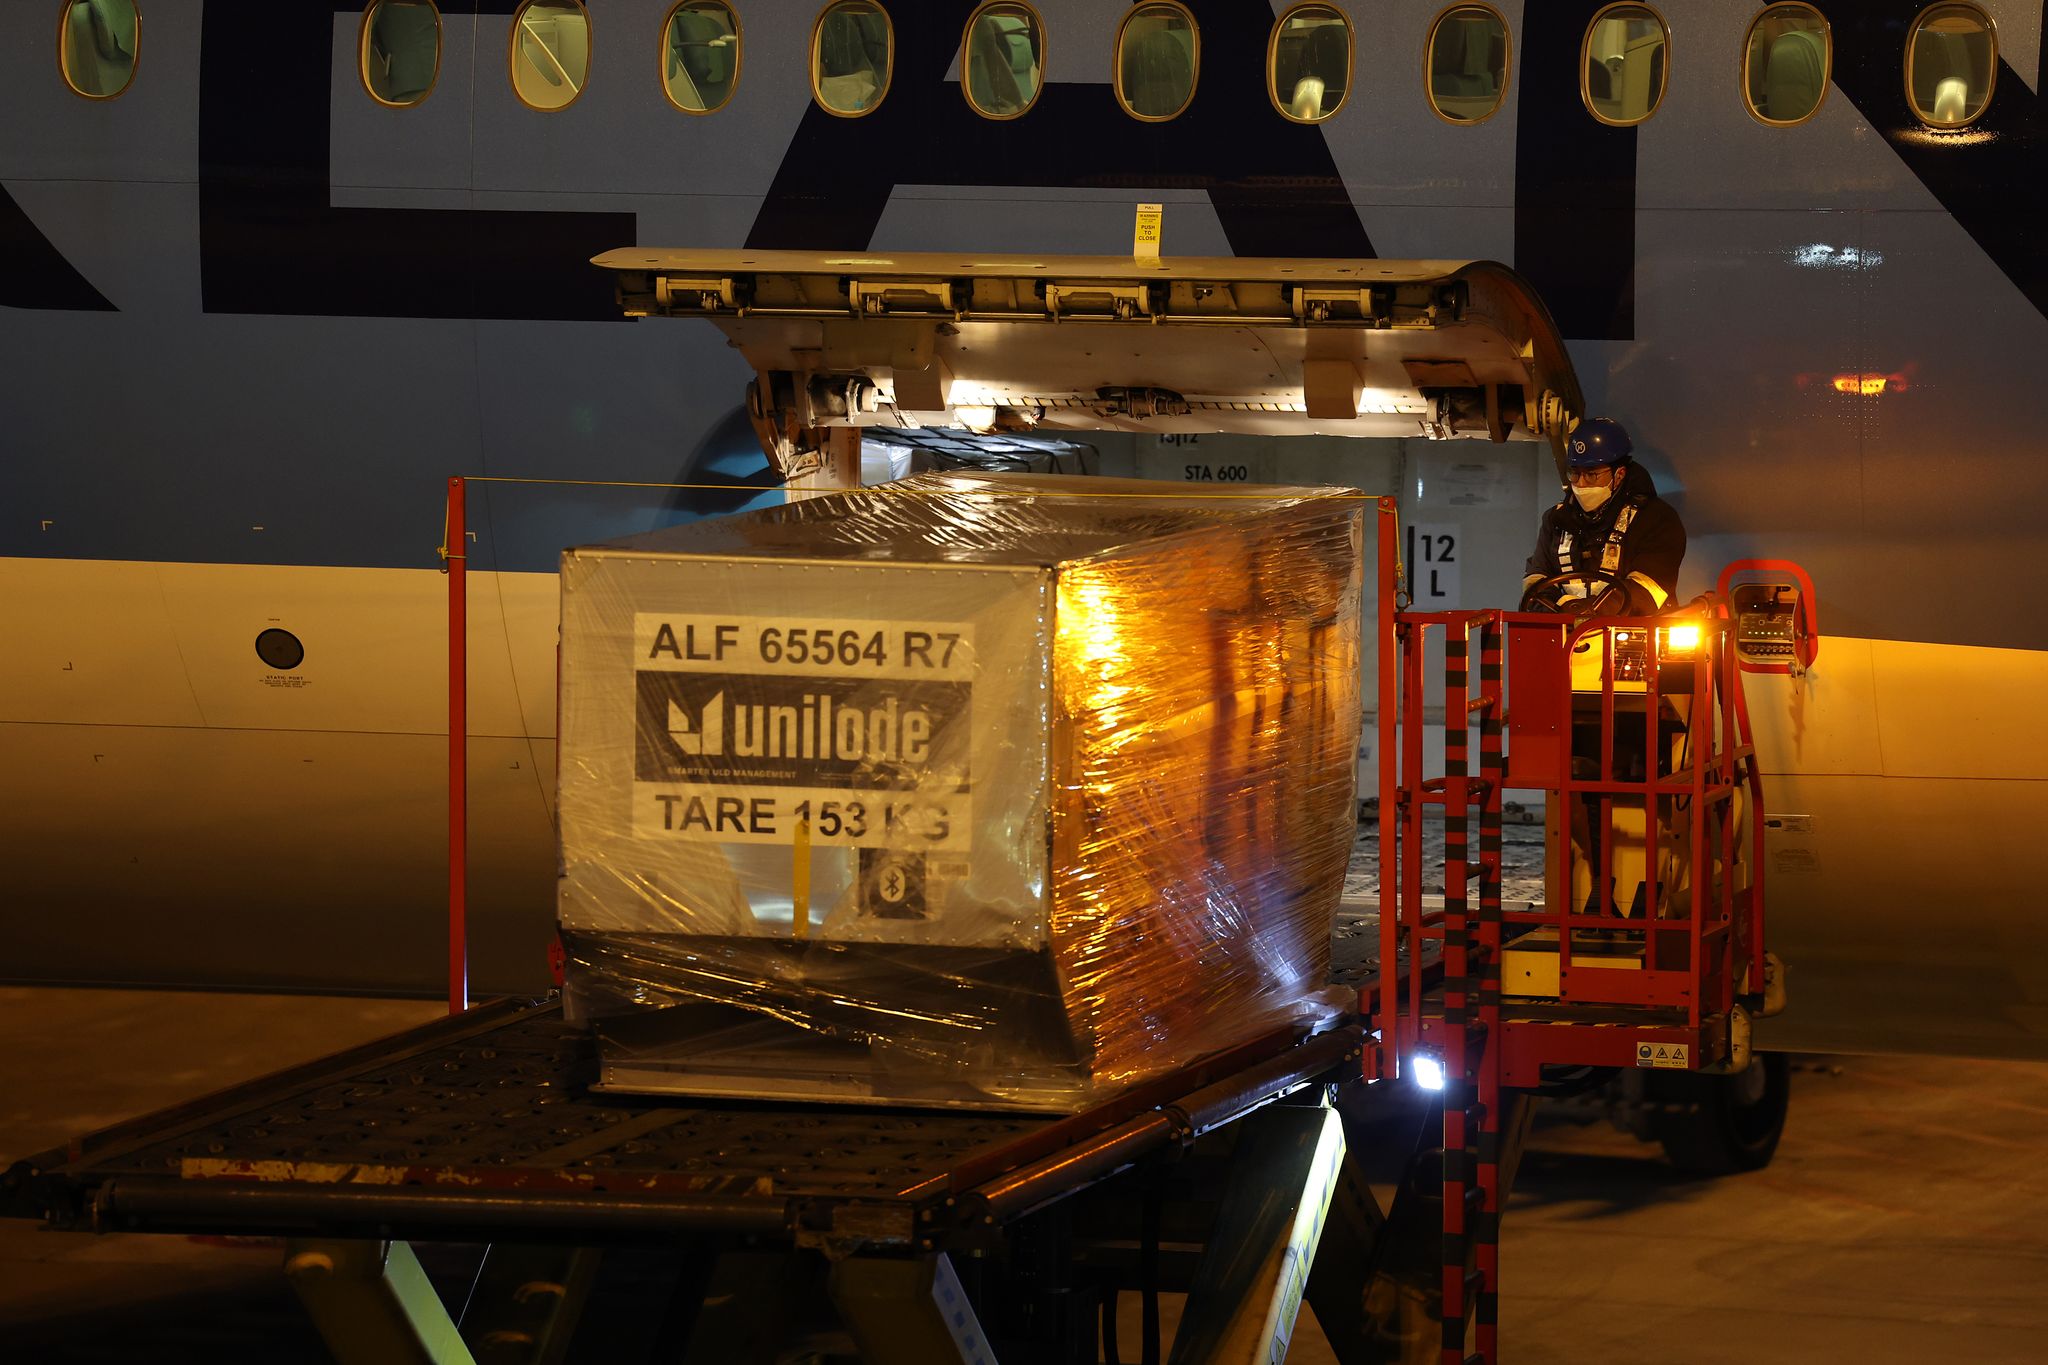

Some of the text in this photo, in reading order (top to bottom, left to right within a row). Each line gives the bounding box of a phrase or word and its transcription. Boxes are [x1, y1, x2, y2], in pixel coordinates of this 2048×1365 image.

[1185, 465, 1247, 481] STA 600
[1421, 534, 1455, 562] 12
[1430, 570, 1445, 597] L
[648, 623, 961, 669] ALF 65564 R7
[735, 694, 931, 763] unilode
[667, 767, 796, 779] SMARTER ULD MANAGEMENT
[655, 795, 951, 841] TARE 153 KG
